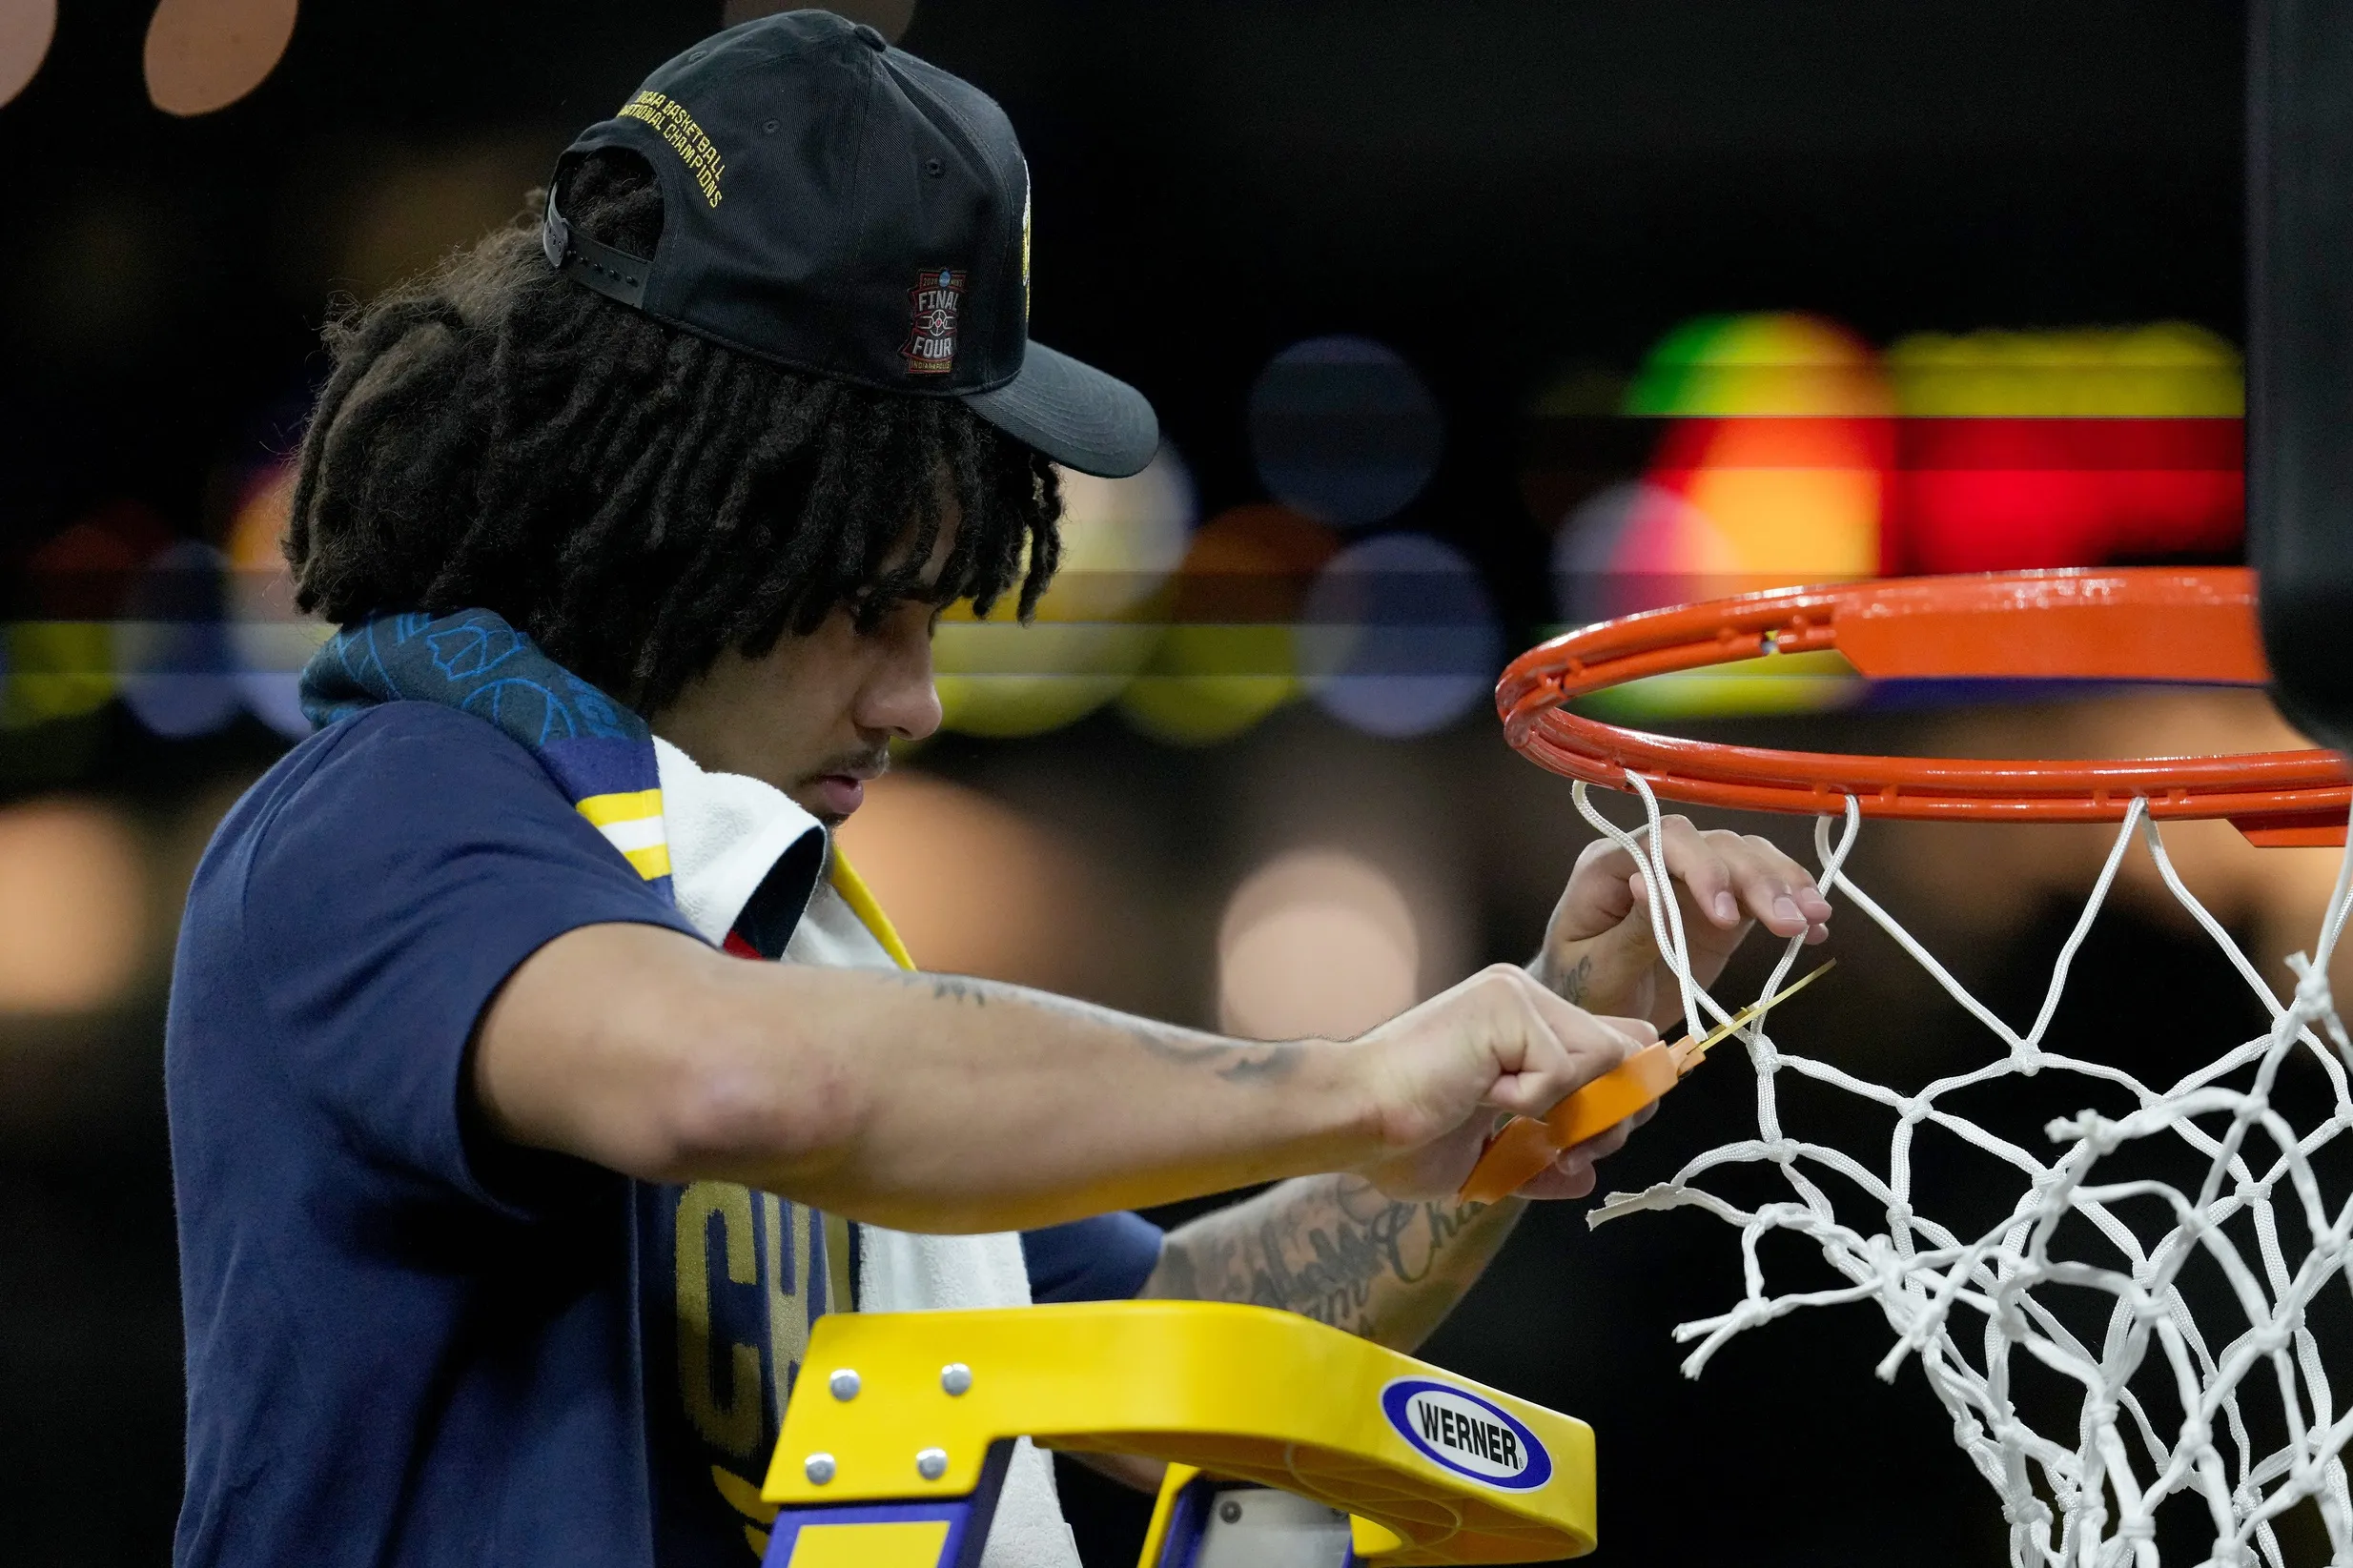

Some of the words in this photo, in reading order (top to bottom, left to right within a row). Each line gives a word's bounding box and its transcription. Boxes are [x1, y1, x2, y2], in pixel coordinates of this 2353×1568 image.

[662, 100, 725, 181] BASKETBALL
[663, 123, 722, 208] CHAMPIONS
[918, 290, 958, 312] FINAL
[912, 336, 952, 358] FOUR
[1417, 1399, 1519, 1470] WERNER
